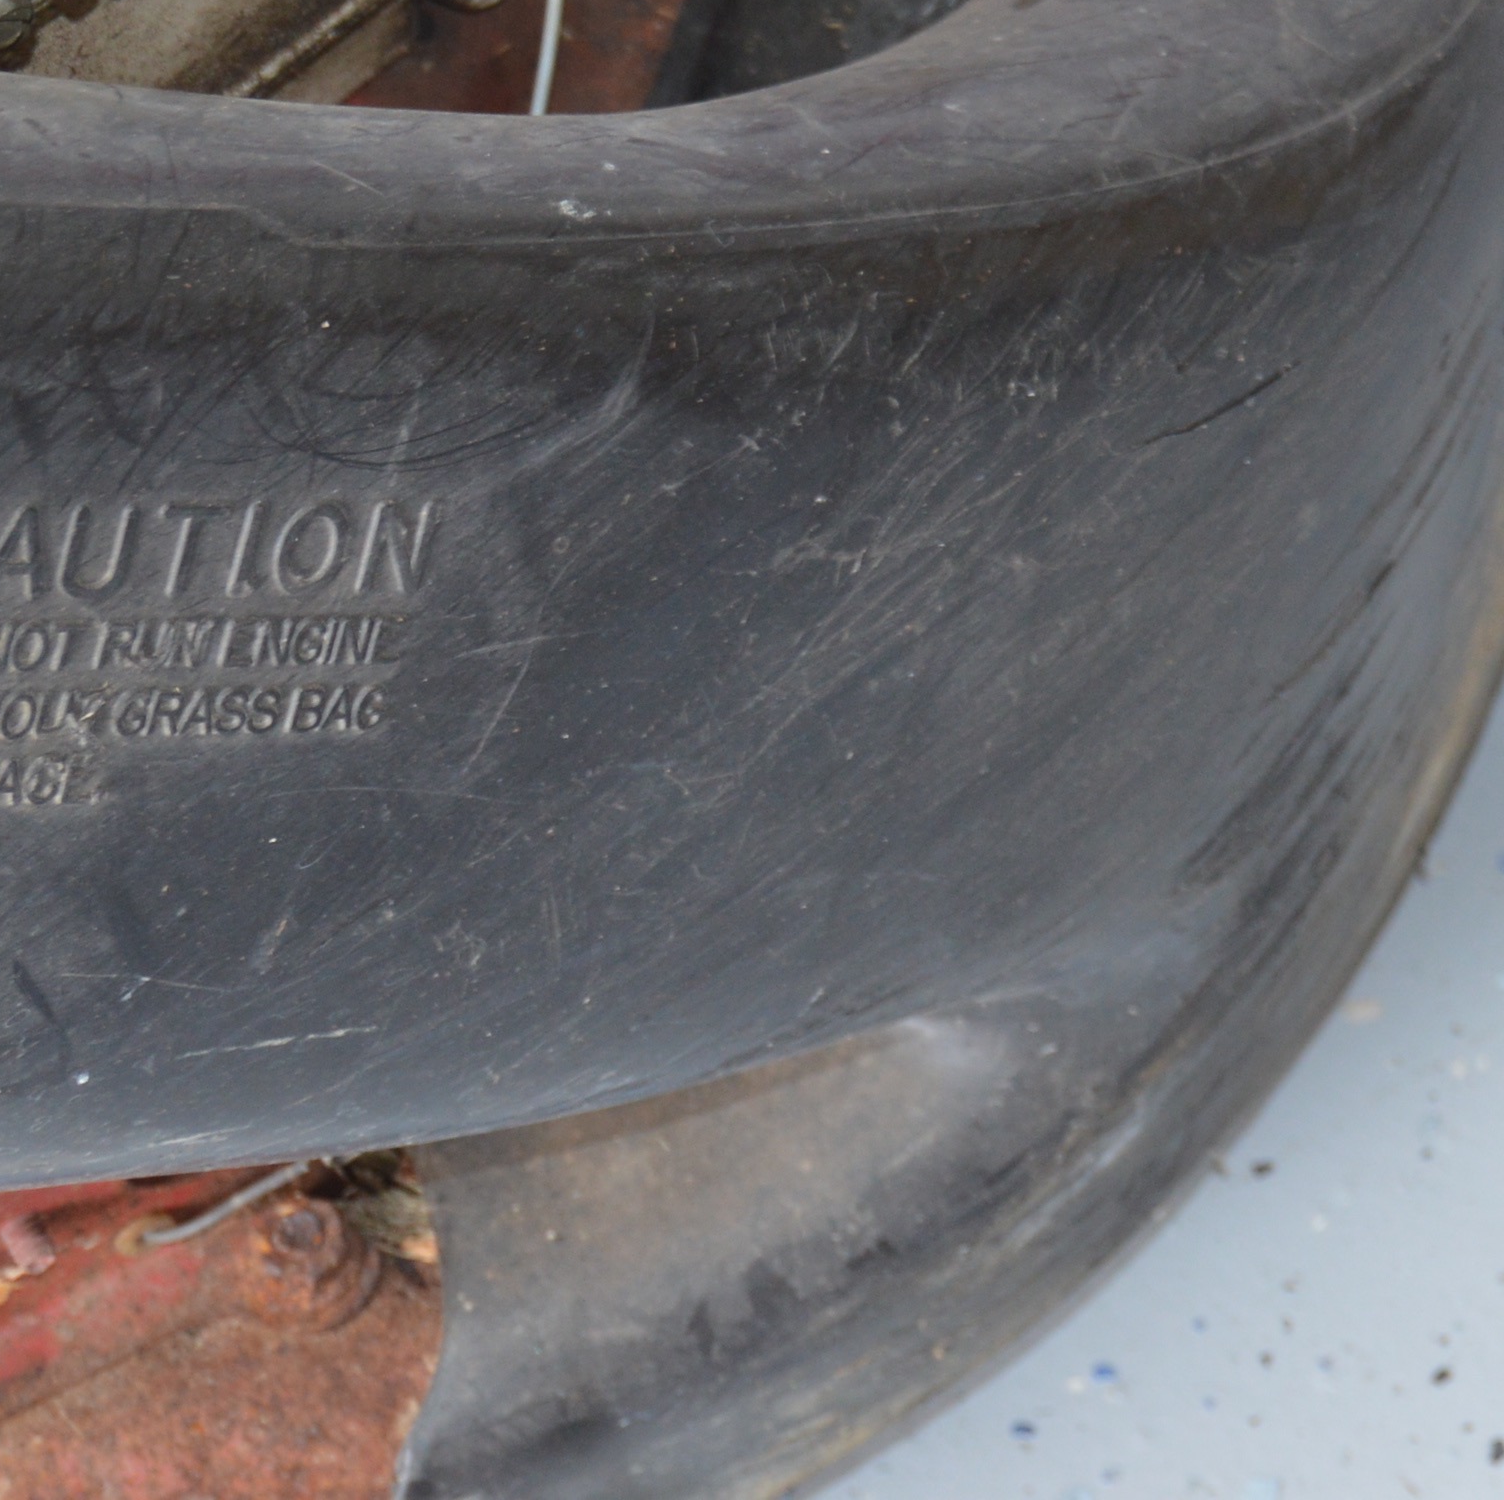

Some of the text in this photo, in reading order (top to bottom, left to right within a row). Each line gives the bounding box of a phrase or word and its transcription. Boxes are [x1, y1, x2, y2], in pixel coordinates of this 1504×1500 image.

[91, 618, 216, 671] RUN
[216, 614, 408, 668] ENGINE
[112, 684, 282, 738] GRASS
[283, 682, 388, 736] BAG
